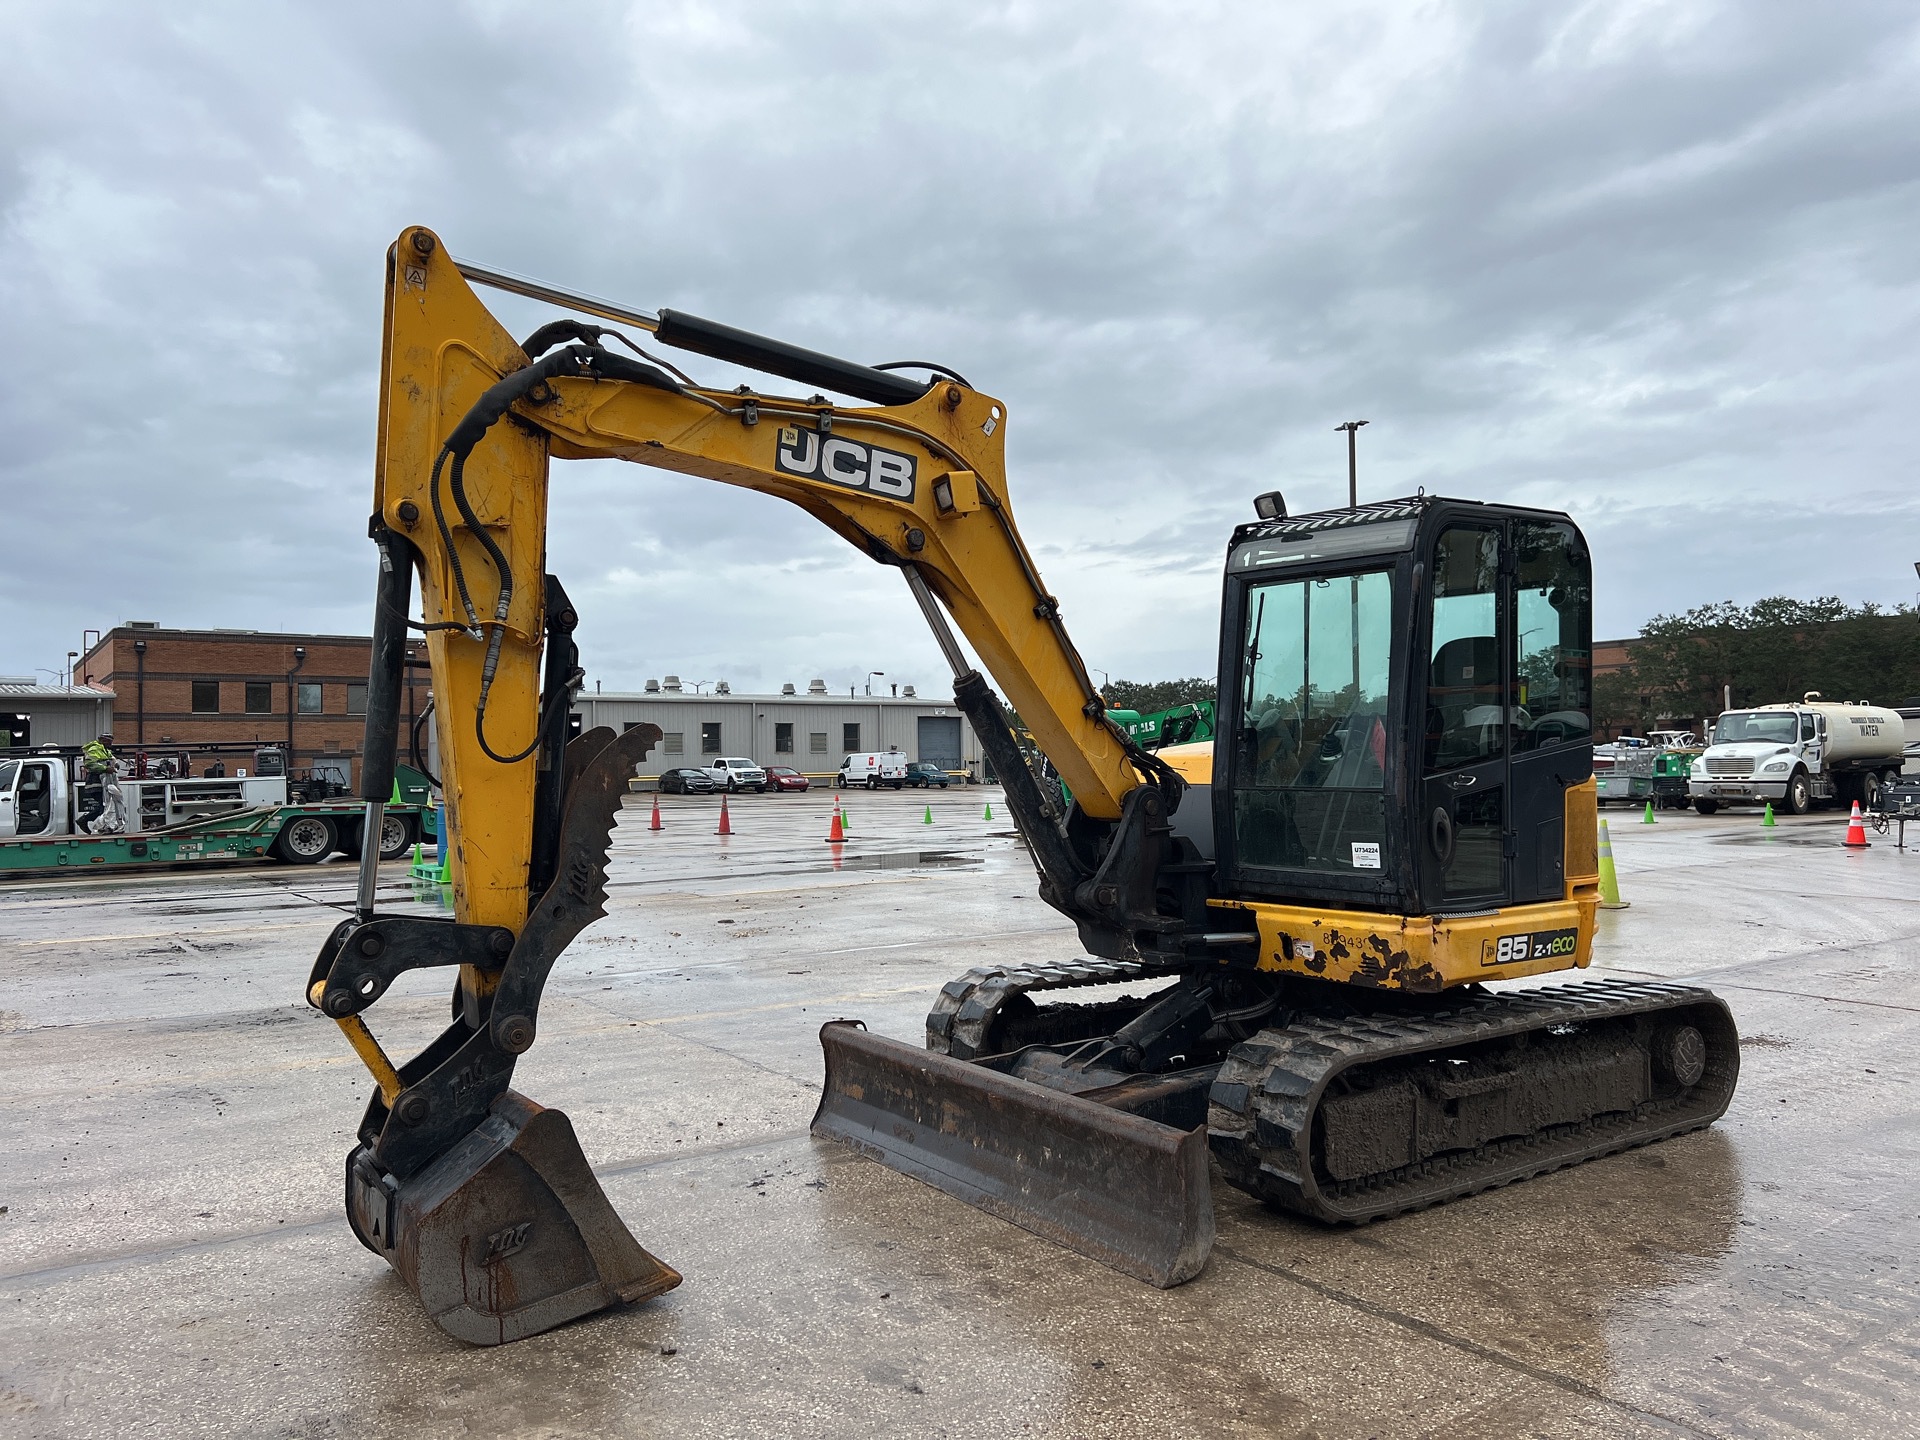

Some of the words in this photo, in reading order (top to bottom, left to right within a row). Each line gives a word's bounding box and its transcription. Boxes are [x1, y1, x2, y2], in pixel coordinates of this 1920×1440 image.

[780, 432, 912, 498] JCB
[1860, 724, 1880, 737] WATER
[1496, 935, 1528, 962] 85
